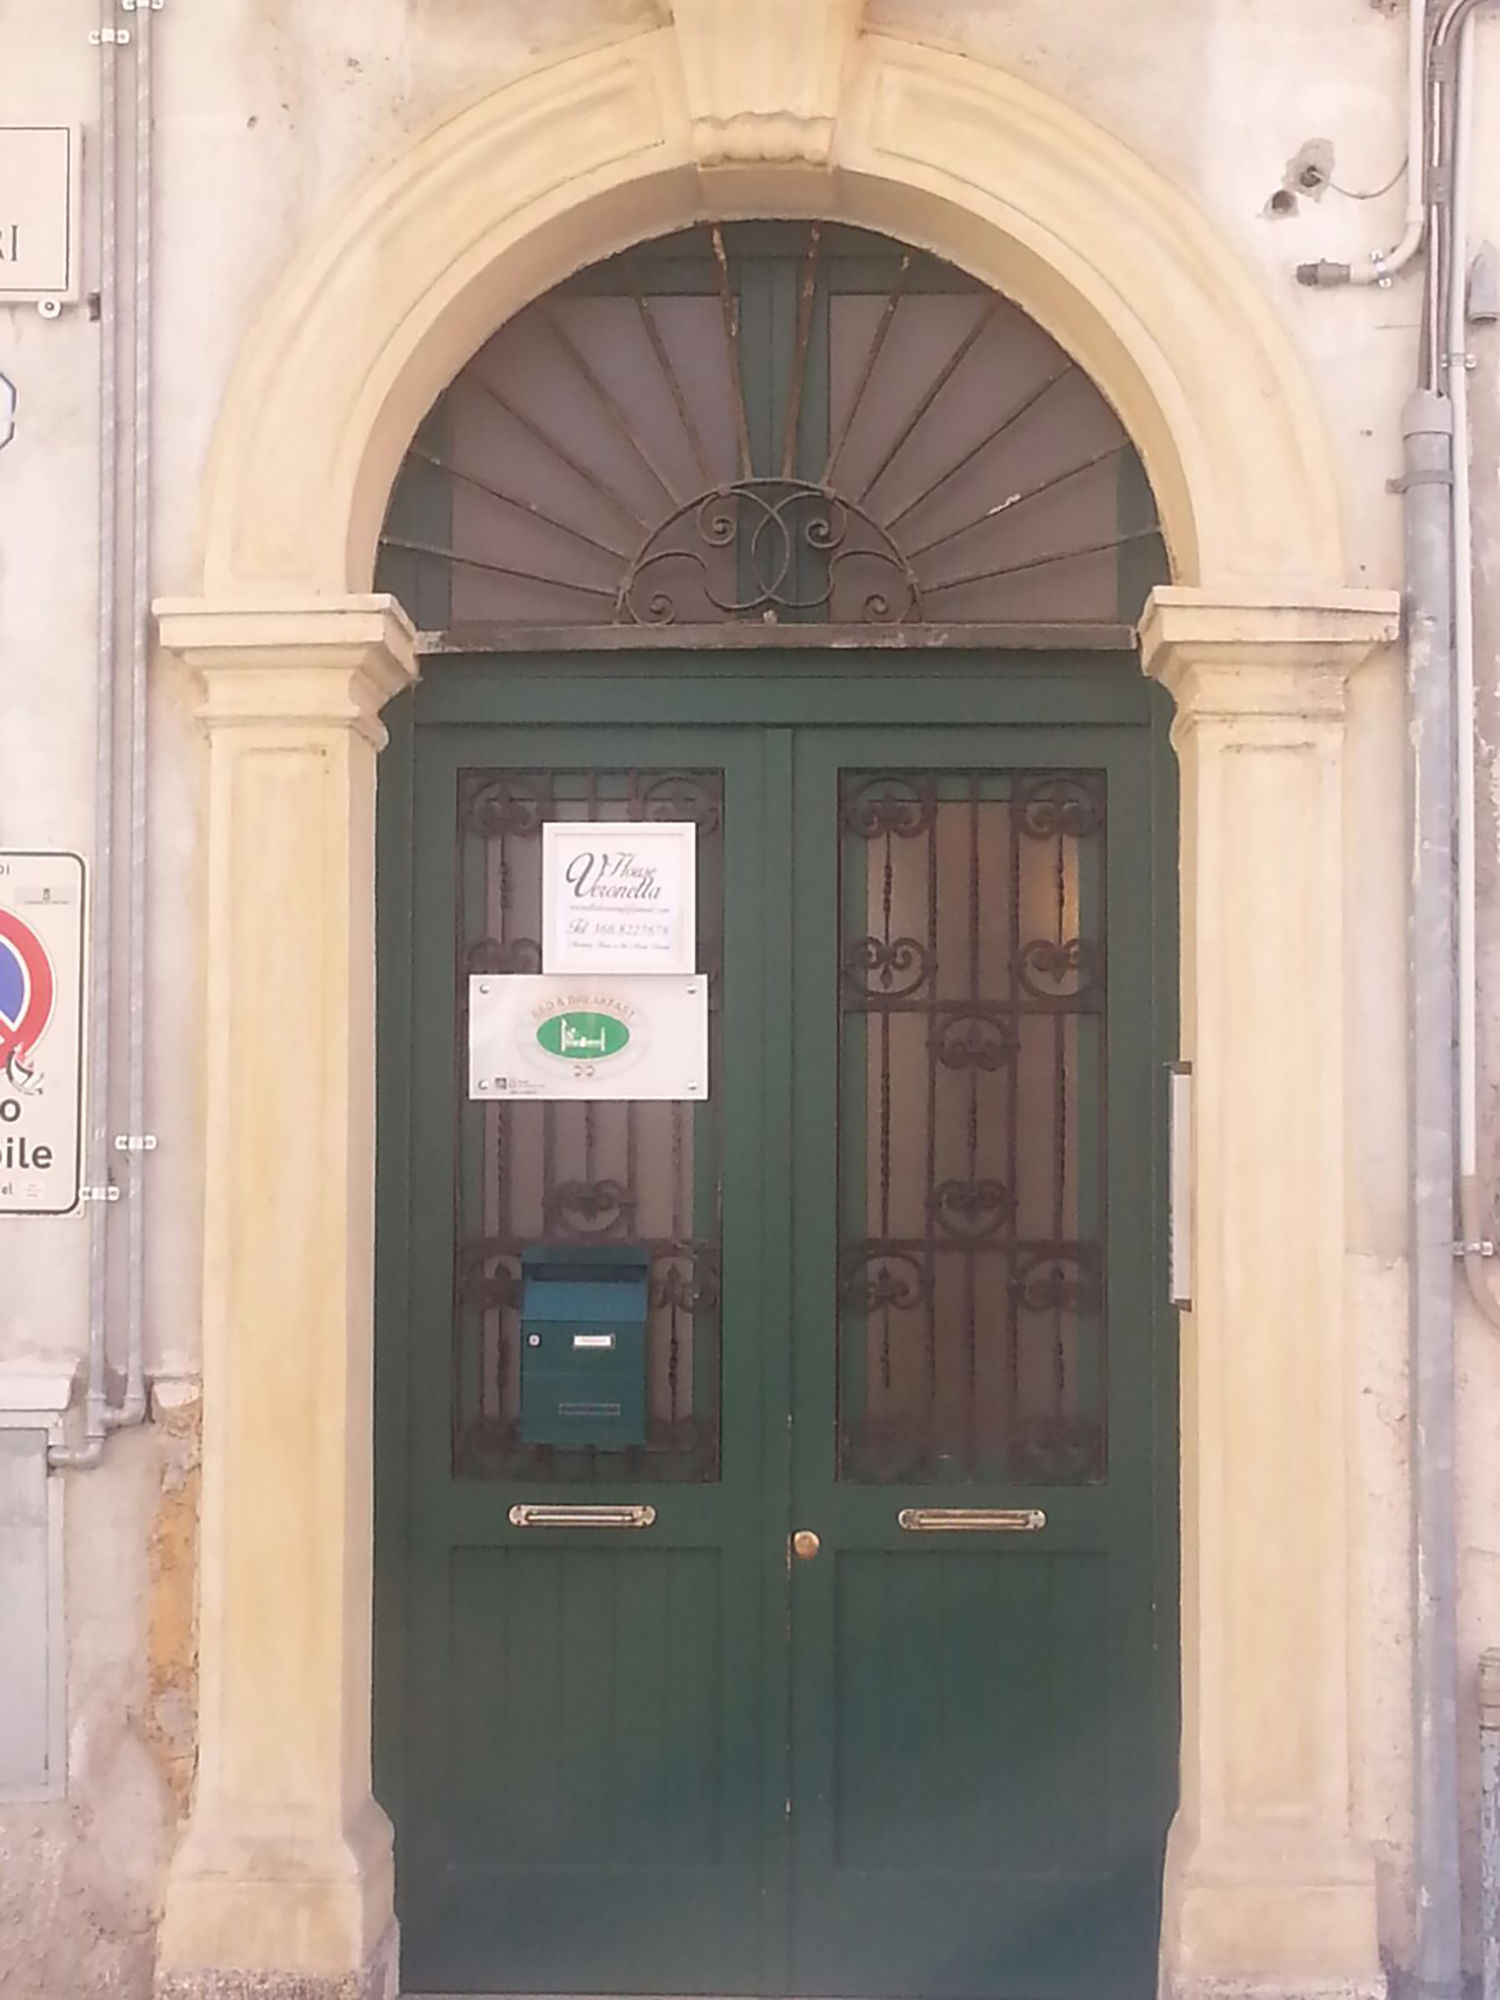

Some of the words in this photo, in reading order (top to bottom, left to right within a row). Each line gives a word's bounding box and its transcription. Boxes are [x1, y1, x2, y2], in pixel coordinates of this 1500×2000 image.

[0, 224, 19, 262] I
[566, 852, 661, 899] Veronella
[0, 1136, 53, 1169] ile
